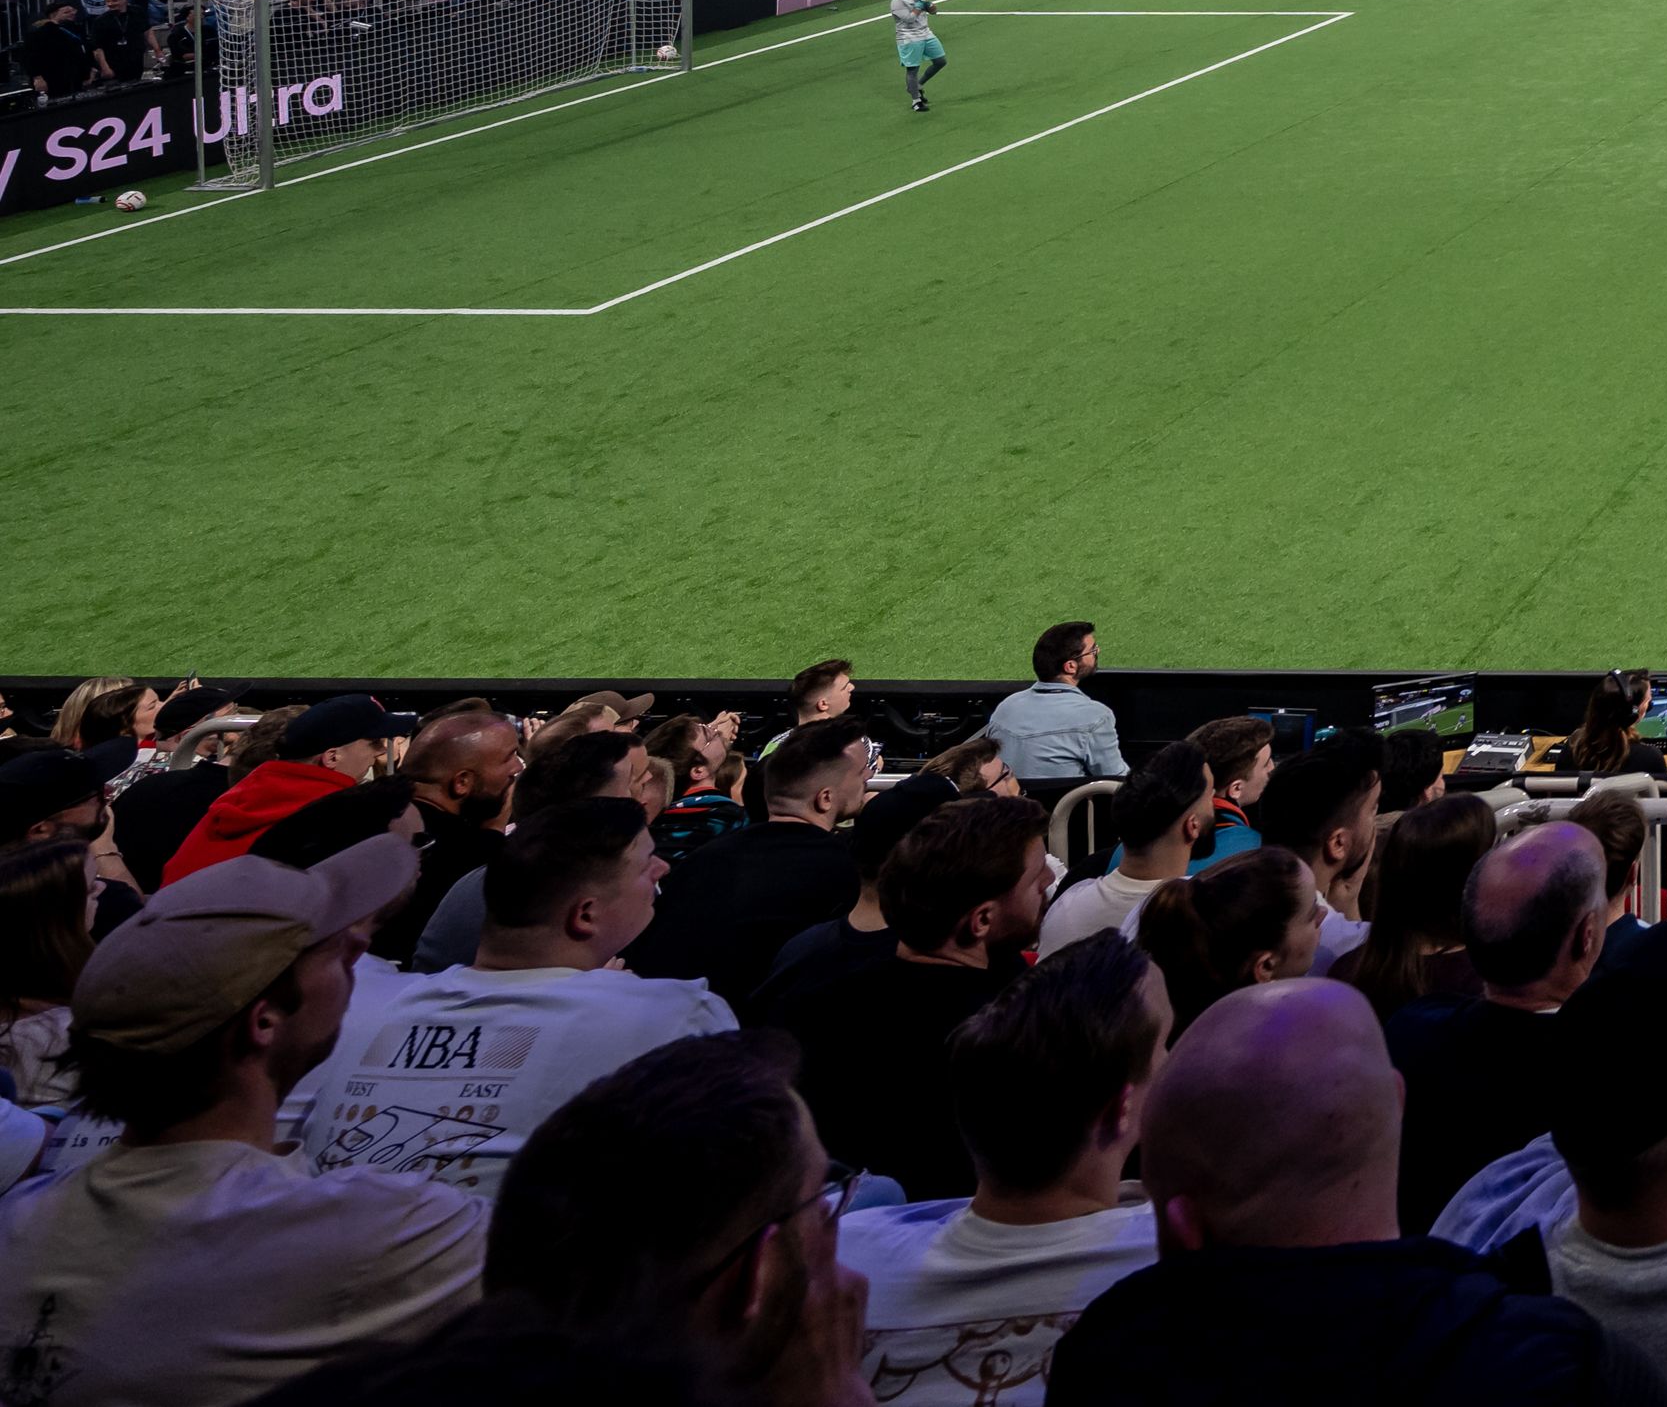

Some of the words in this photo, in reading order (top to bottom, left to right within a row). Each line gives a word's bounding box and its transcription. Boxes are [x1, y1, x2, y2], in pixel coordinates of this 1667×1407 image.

[45, 106, 171, 181] S24
[387, 1025, 483, 1070] NBA
[458, 1083, 509, 1098] EAST
